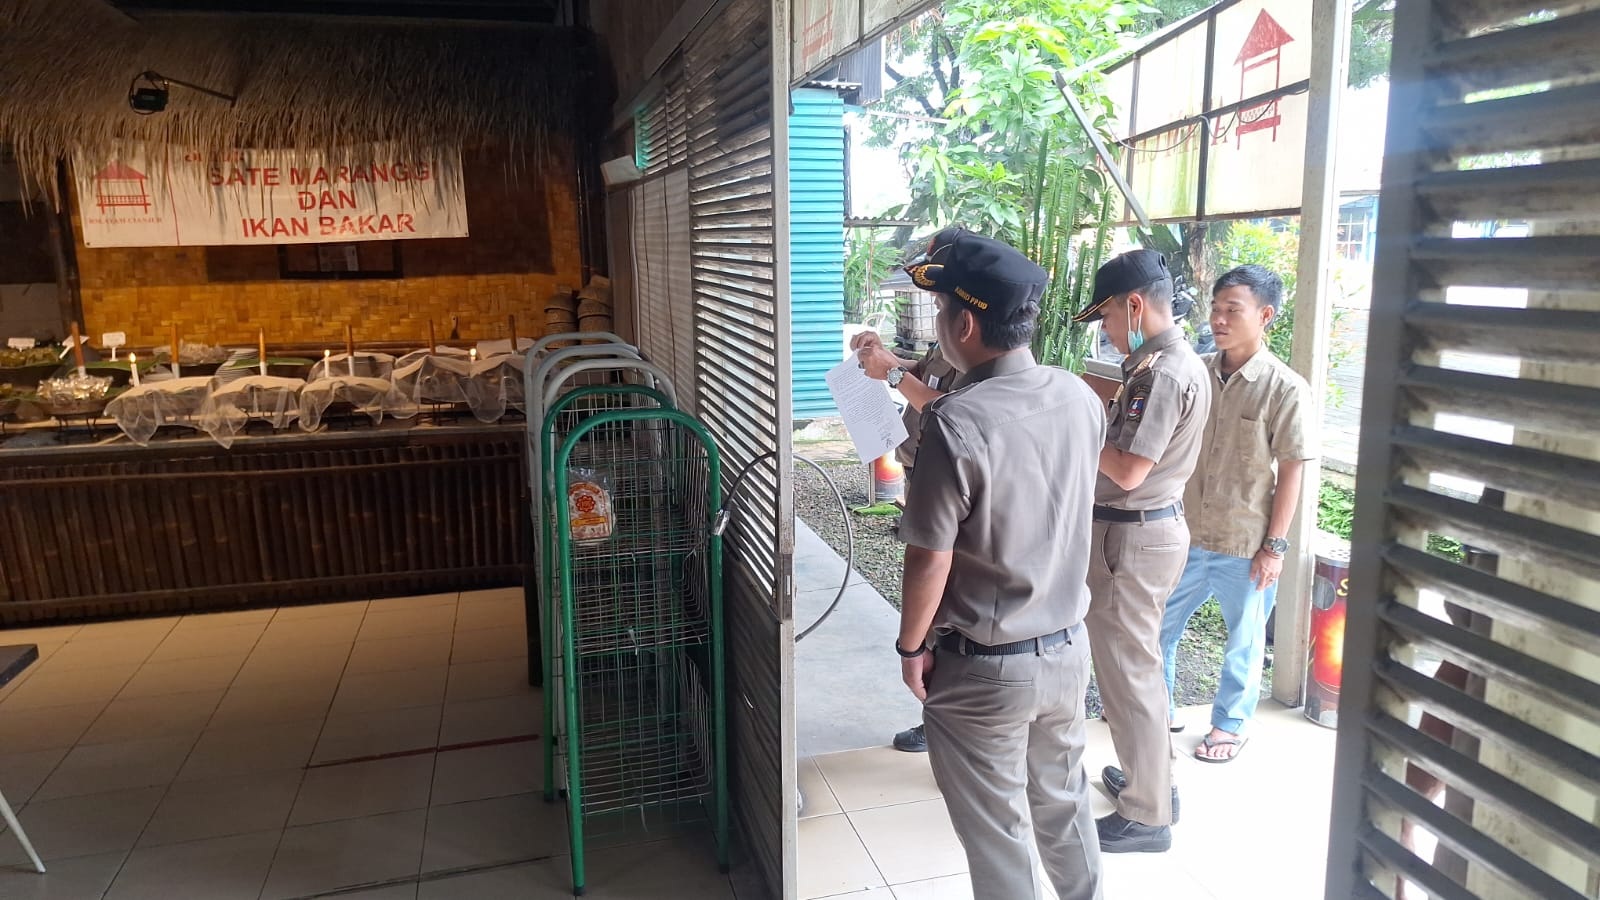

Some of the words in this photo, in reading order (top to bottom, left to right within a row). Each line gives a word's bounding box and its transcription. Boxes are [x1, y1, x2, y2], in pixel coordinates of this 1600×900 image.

[210, 167, 280, 186] SATE
[289, 160, 437, 186] MARANGG
[297, 190, 357, 211] DAN
[242, 217, 309, 238] IKAN
[319, 213, 416, 236] BAKAR
